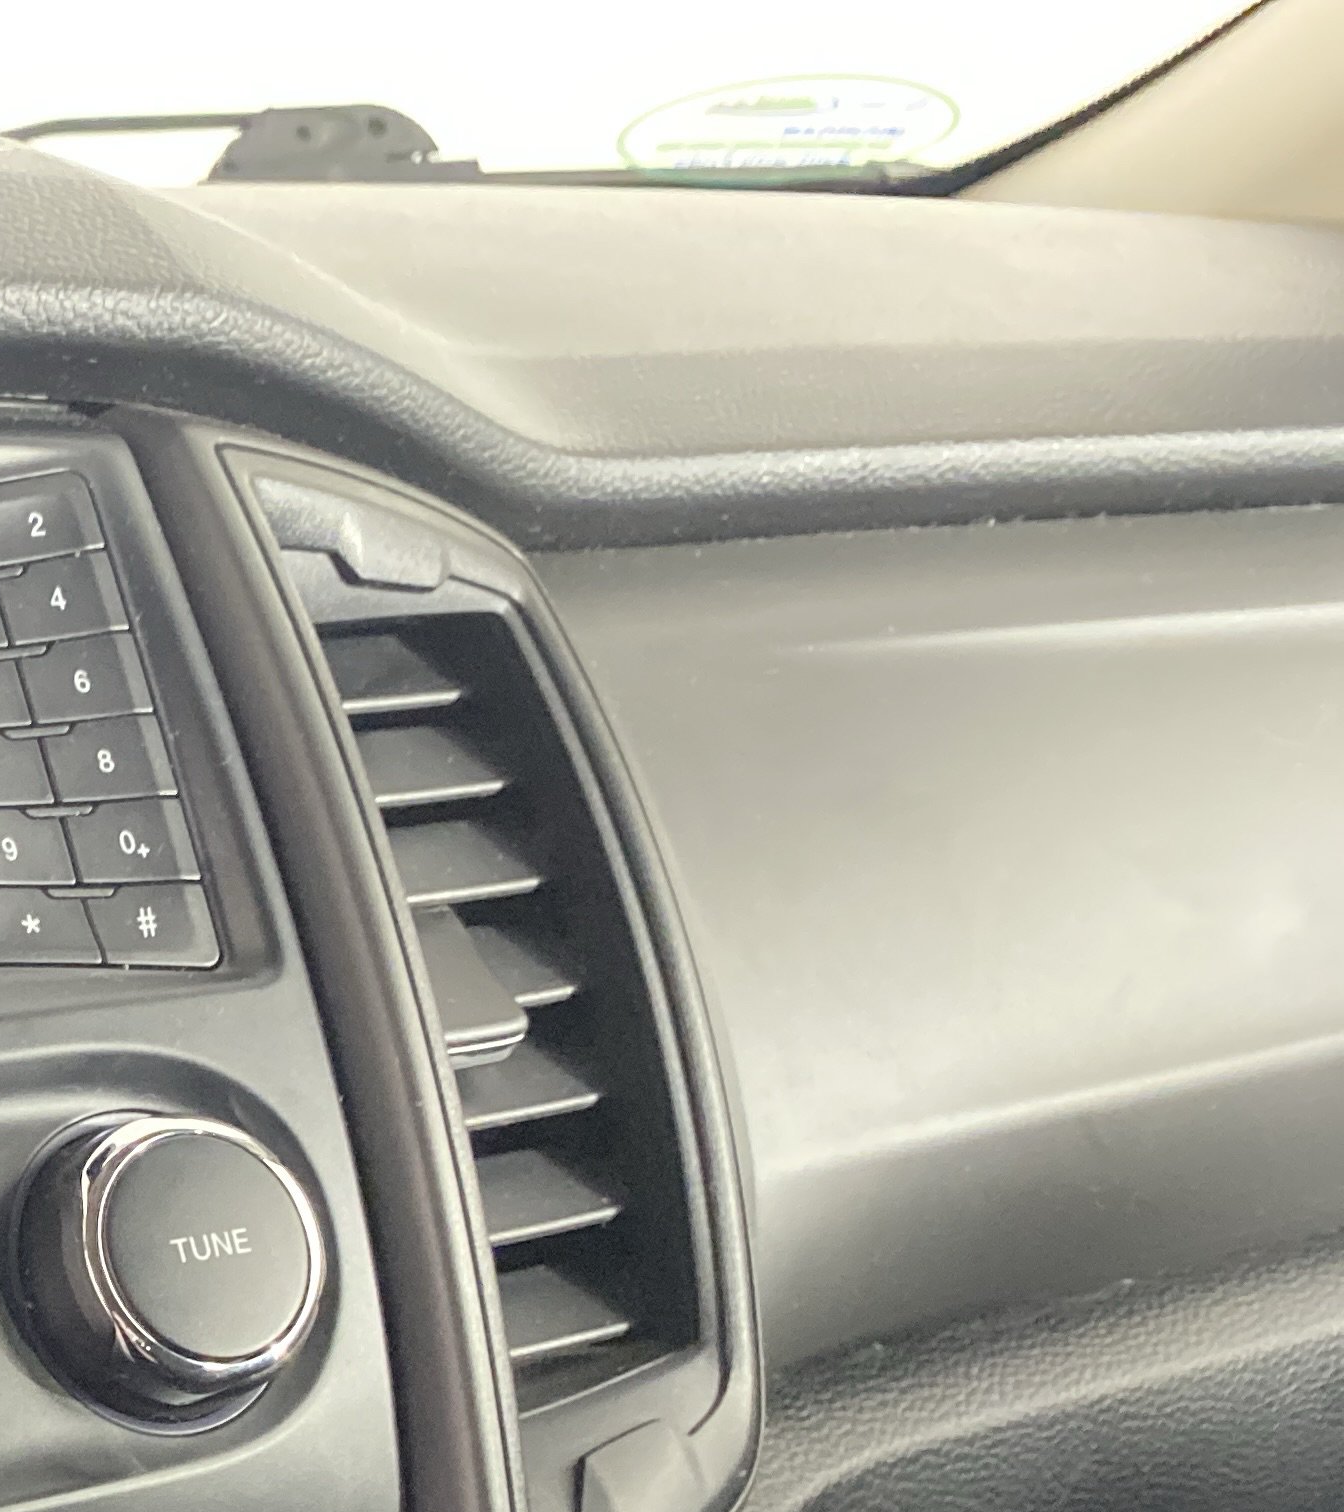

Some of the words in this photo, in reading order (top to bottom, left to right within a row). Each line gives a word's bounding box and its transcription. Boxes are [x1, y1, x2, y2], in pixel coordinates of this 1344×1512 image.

[27, 511, 47, 538] 2
[50, 586, 67, 611] 4
[73, 668, 91, 694] 6
[97, 749, 115, 774] 8
[0, 837, 19, 862] 9
[169, 1226, 253, 1264] TUNE
